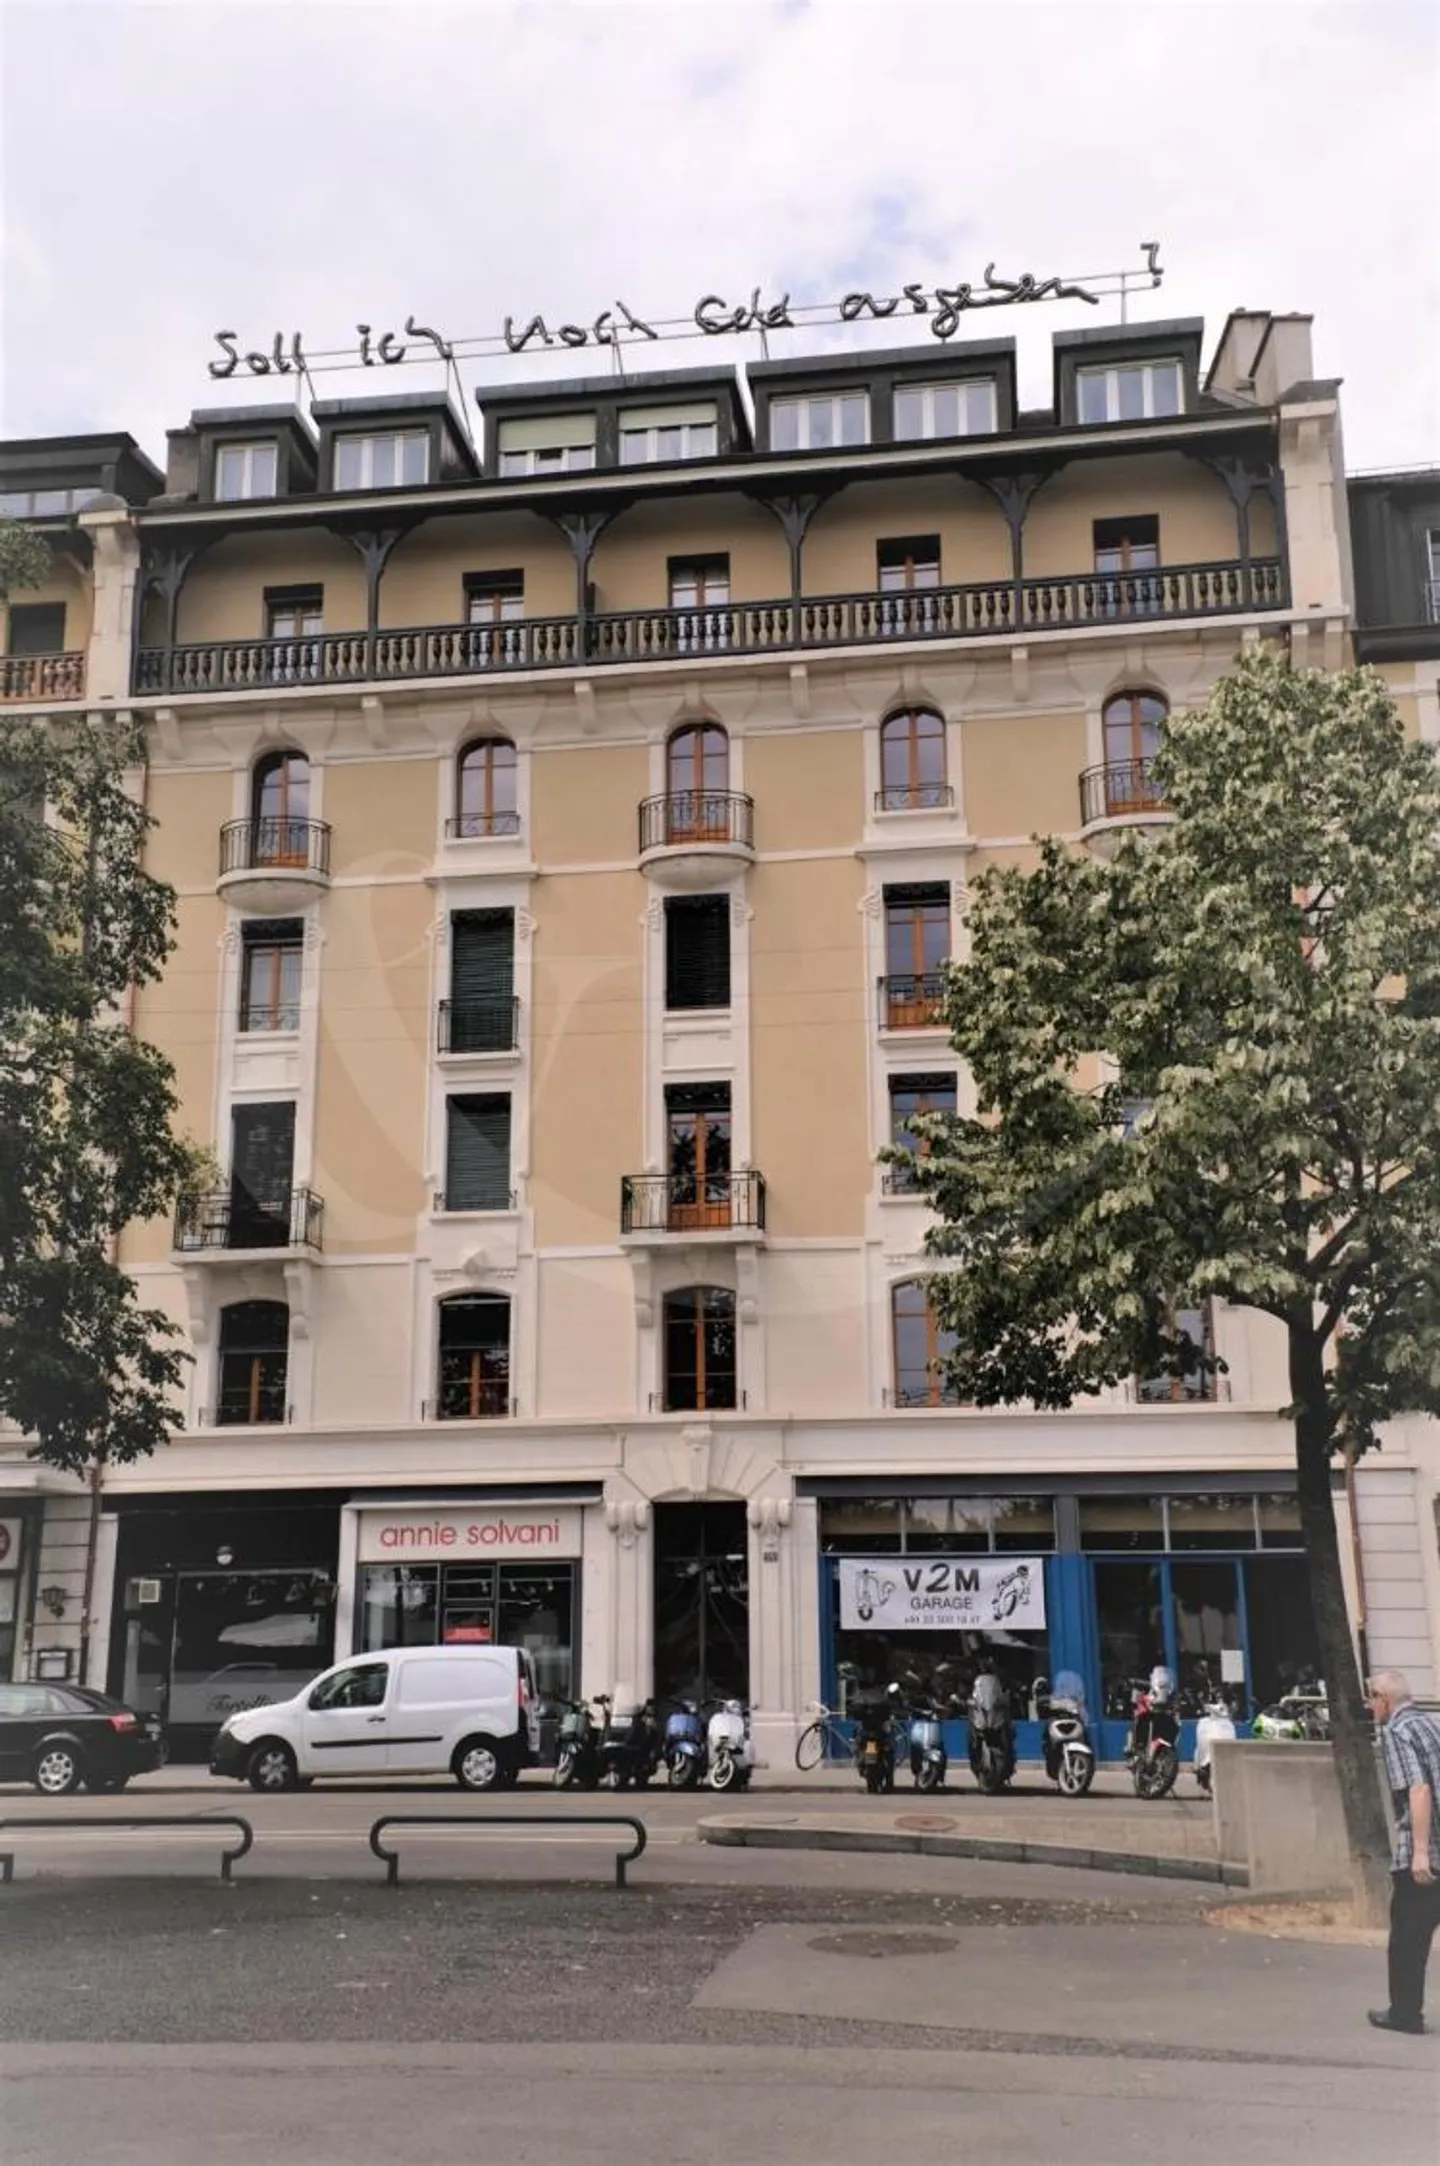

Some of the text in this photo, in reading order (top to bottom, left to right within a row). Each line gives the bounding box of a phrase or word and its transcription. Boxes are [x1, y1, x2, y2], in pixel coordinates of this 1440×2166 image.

[208, 331, 306, 378] Soll
[356, 316, 453, 366] ich
[380, 1517, 560, 1547] annie solvani
[903, 1562, 981, 1593] V2M
[910, 1597, 973, 1611] GARAGE
